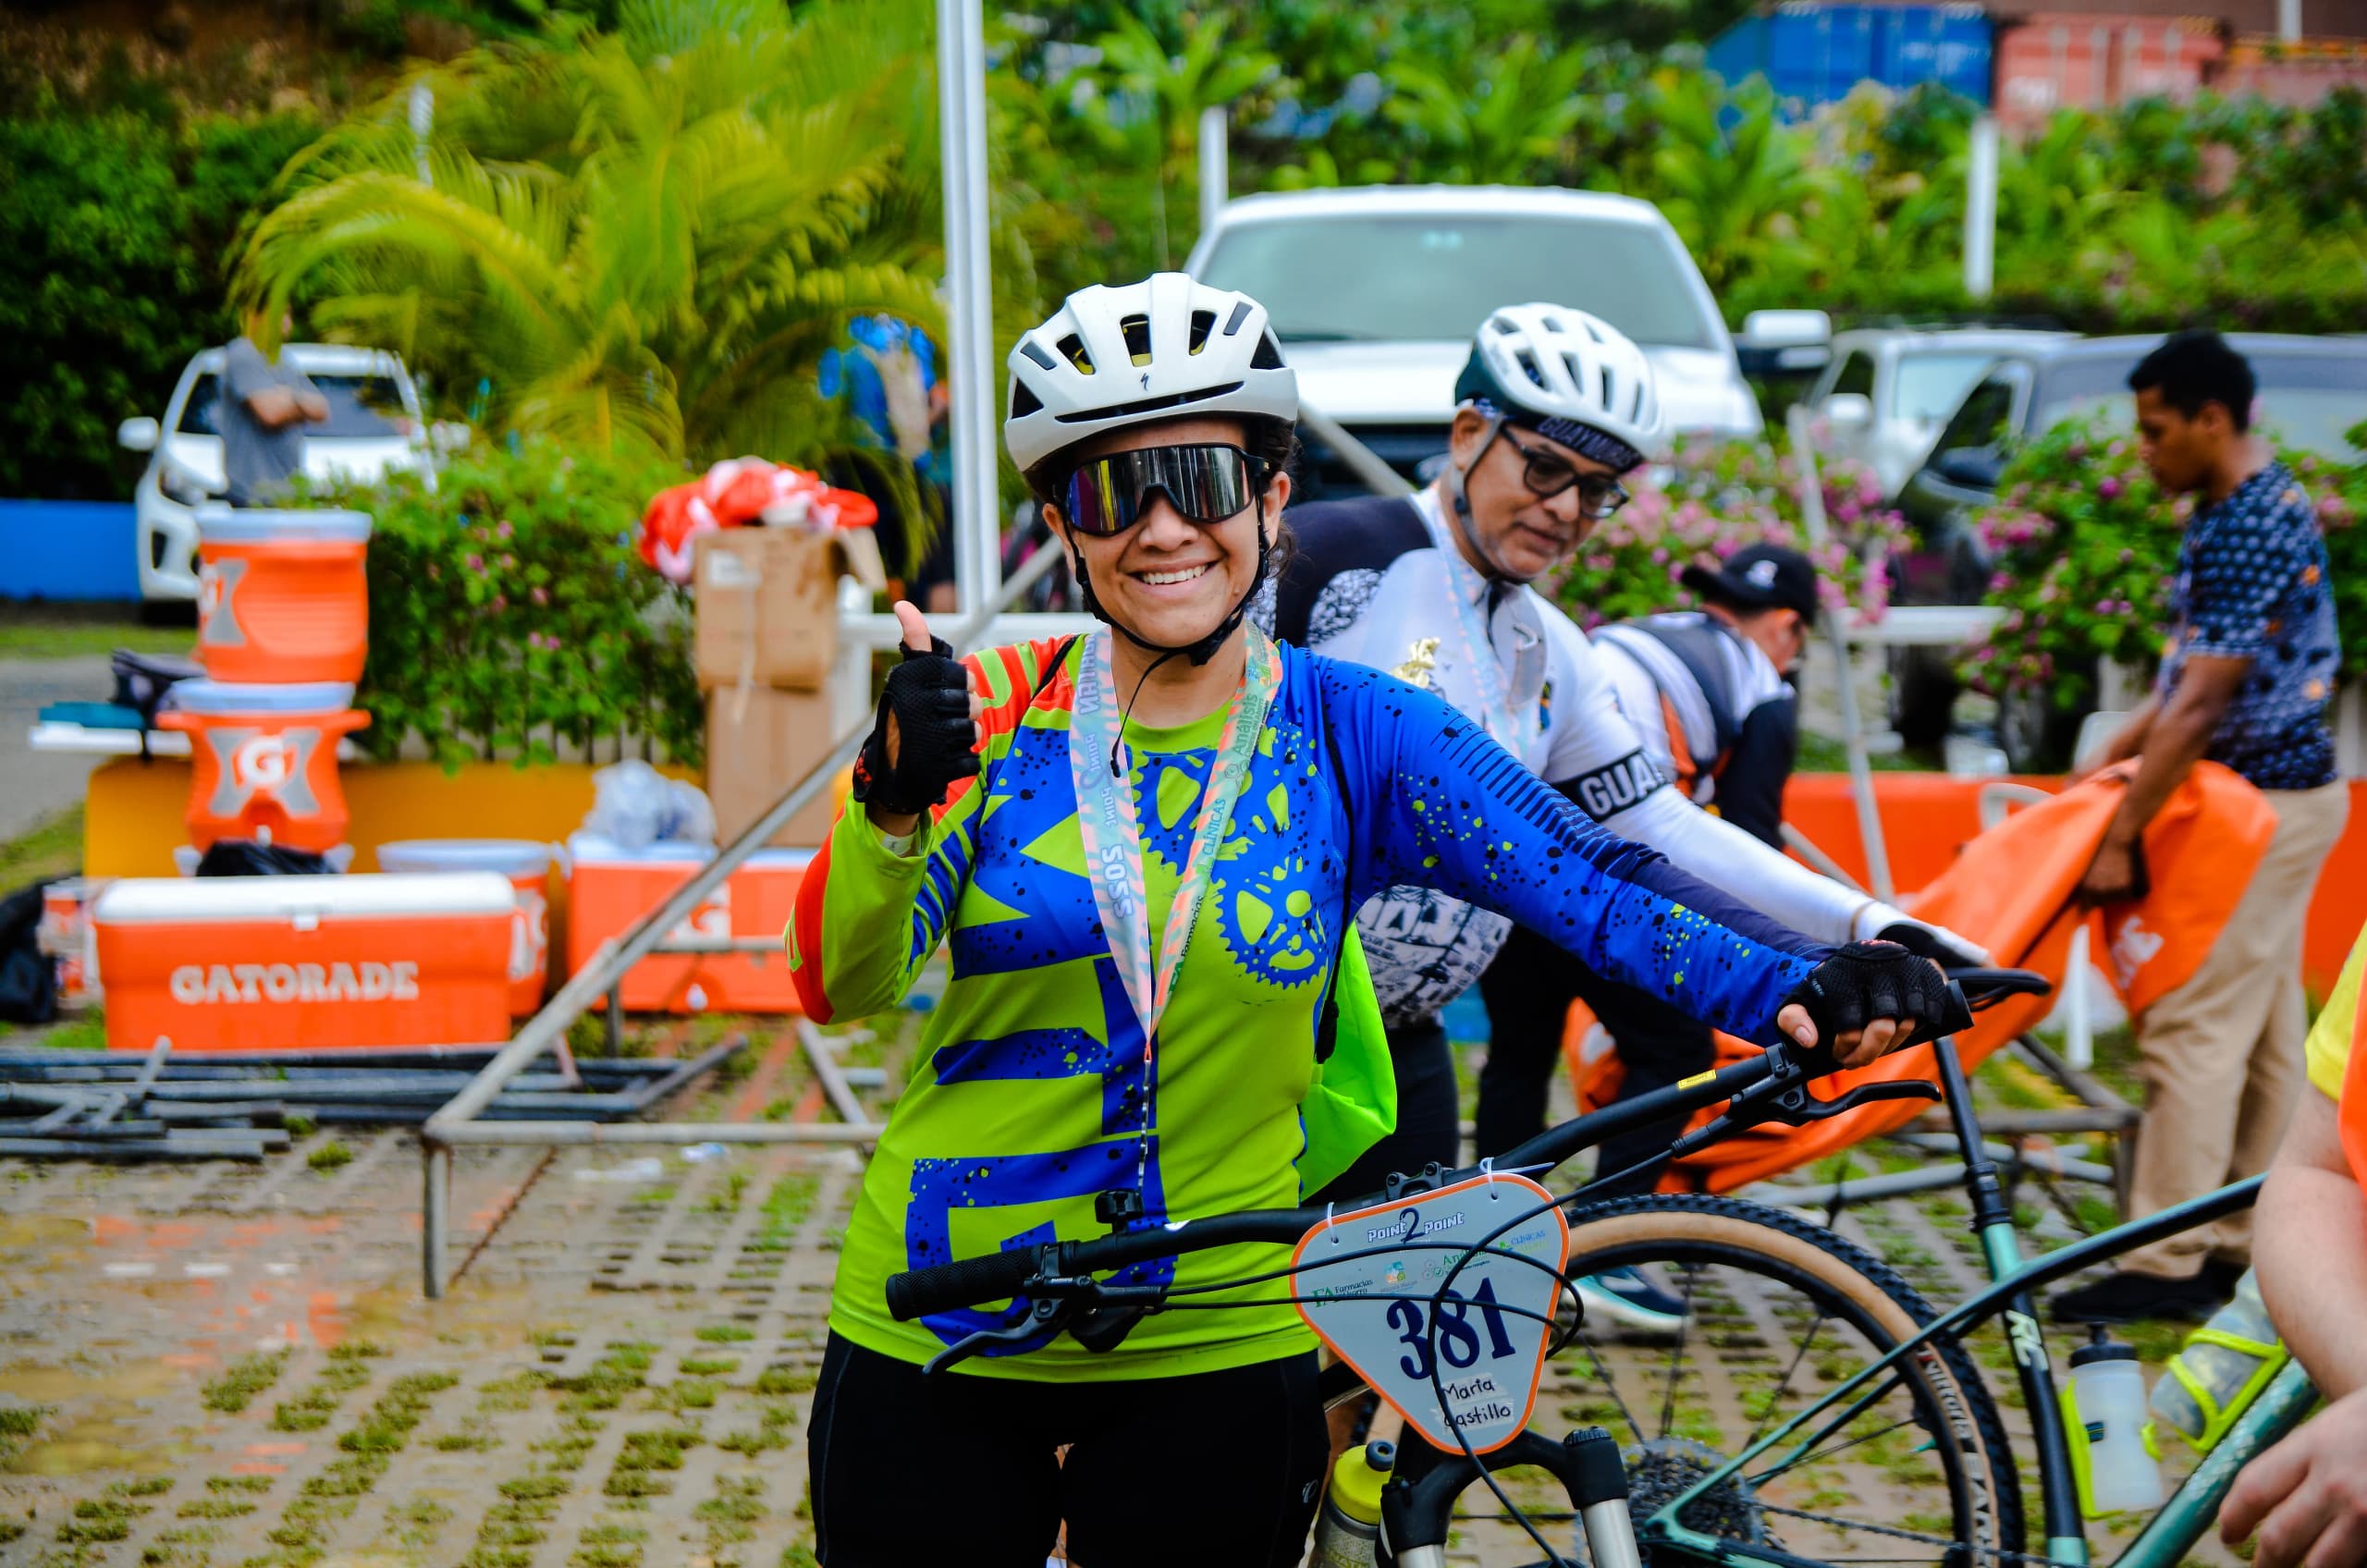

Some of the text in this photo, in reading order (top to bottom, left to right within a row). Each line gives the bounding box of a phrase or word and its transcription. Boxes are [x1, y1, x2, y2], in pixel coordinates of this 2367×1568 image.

[239, 736, 285, 787] G
[1580, 752, 1664, 816] GUA
[170, 962, 420, 1005] GATORADE
[1387, 1277, 1516, 1380] 381
